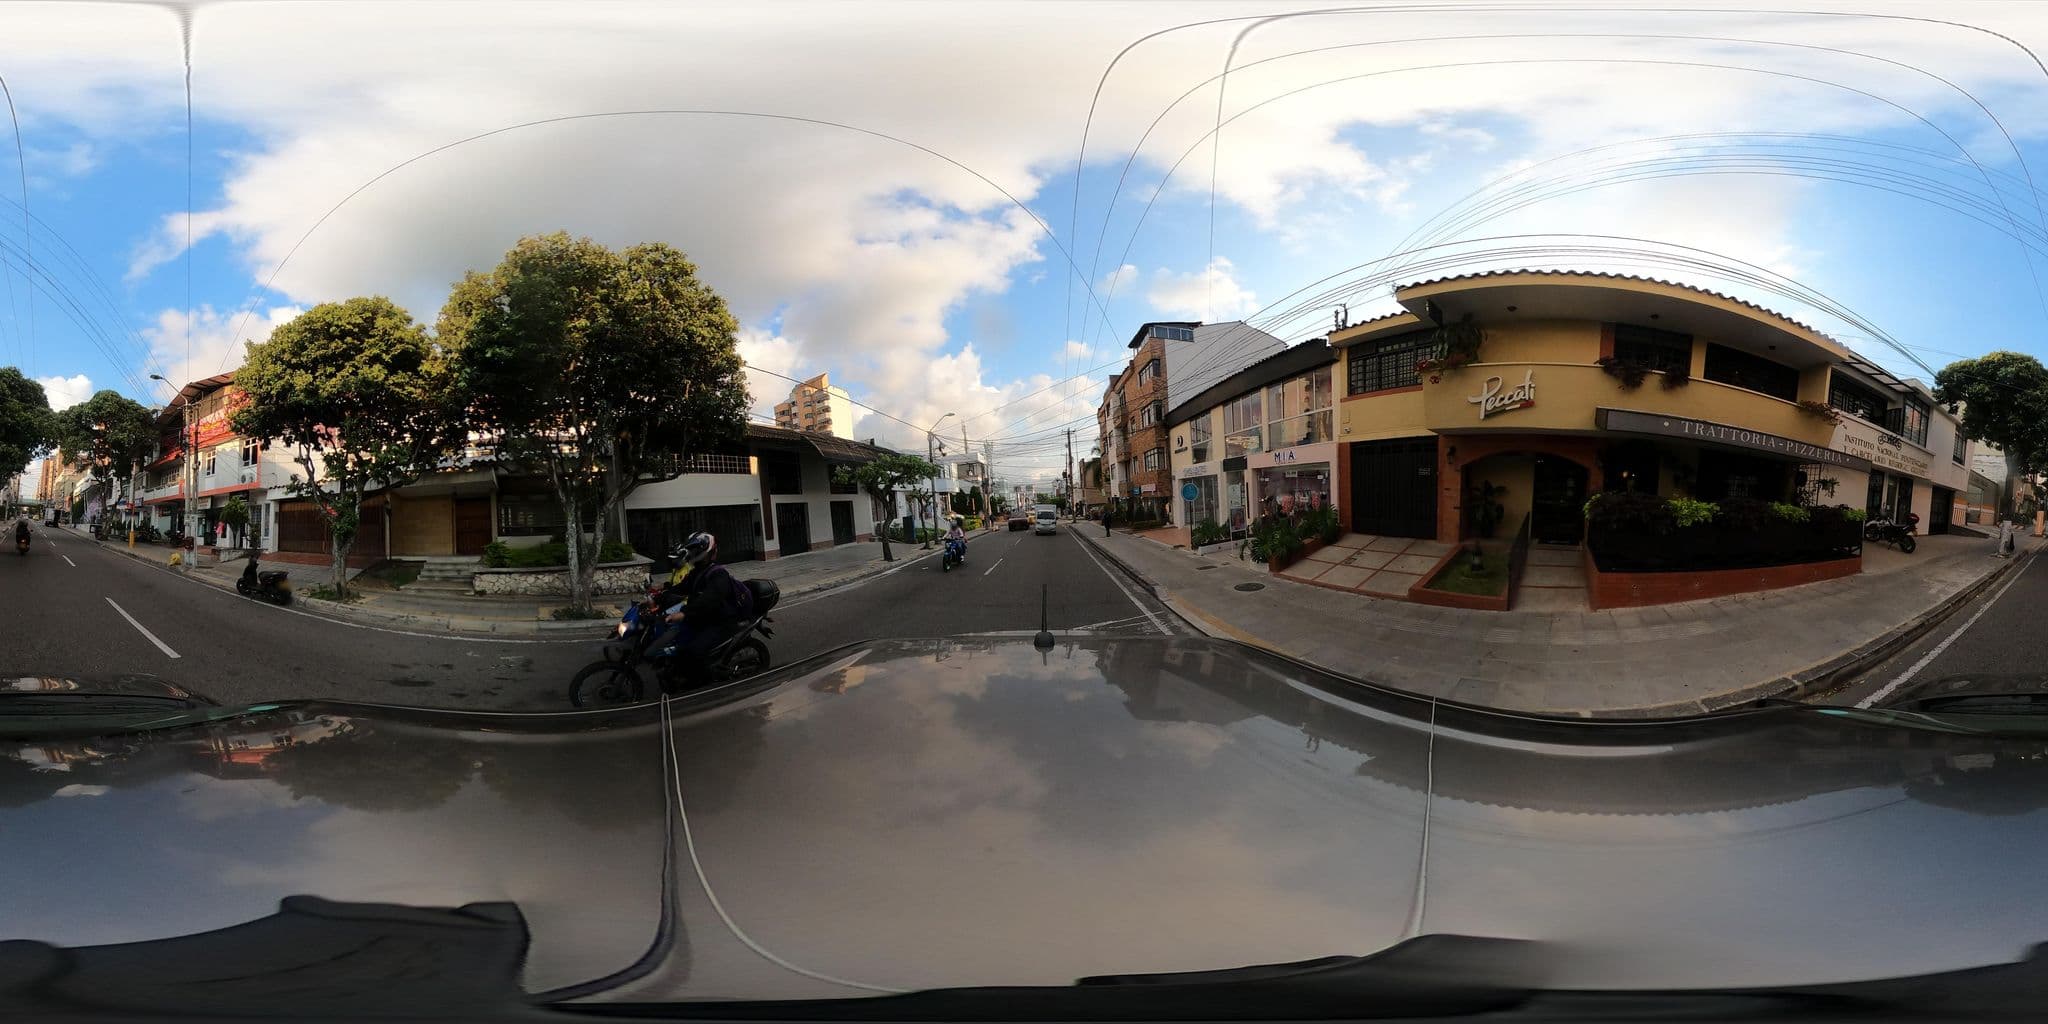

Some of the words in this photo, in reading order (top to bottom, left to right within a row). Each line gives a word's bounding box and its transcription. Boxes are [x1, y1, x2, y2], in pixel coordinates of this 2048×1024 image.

[1468, 369, 1535, 419] Peccati
[1844, 434, 1875, 450] INSTITUTO
[1274, 451, 1295, 462] MIA
